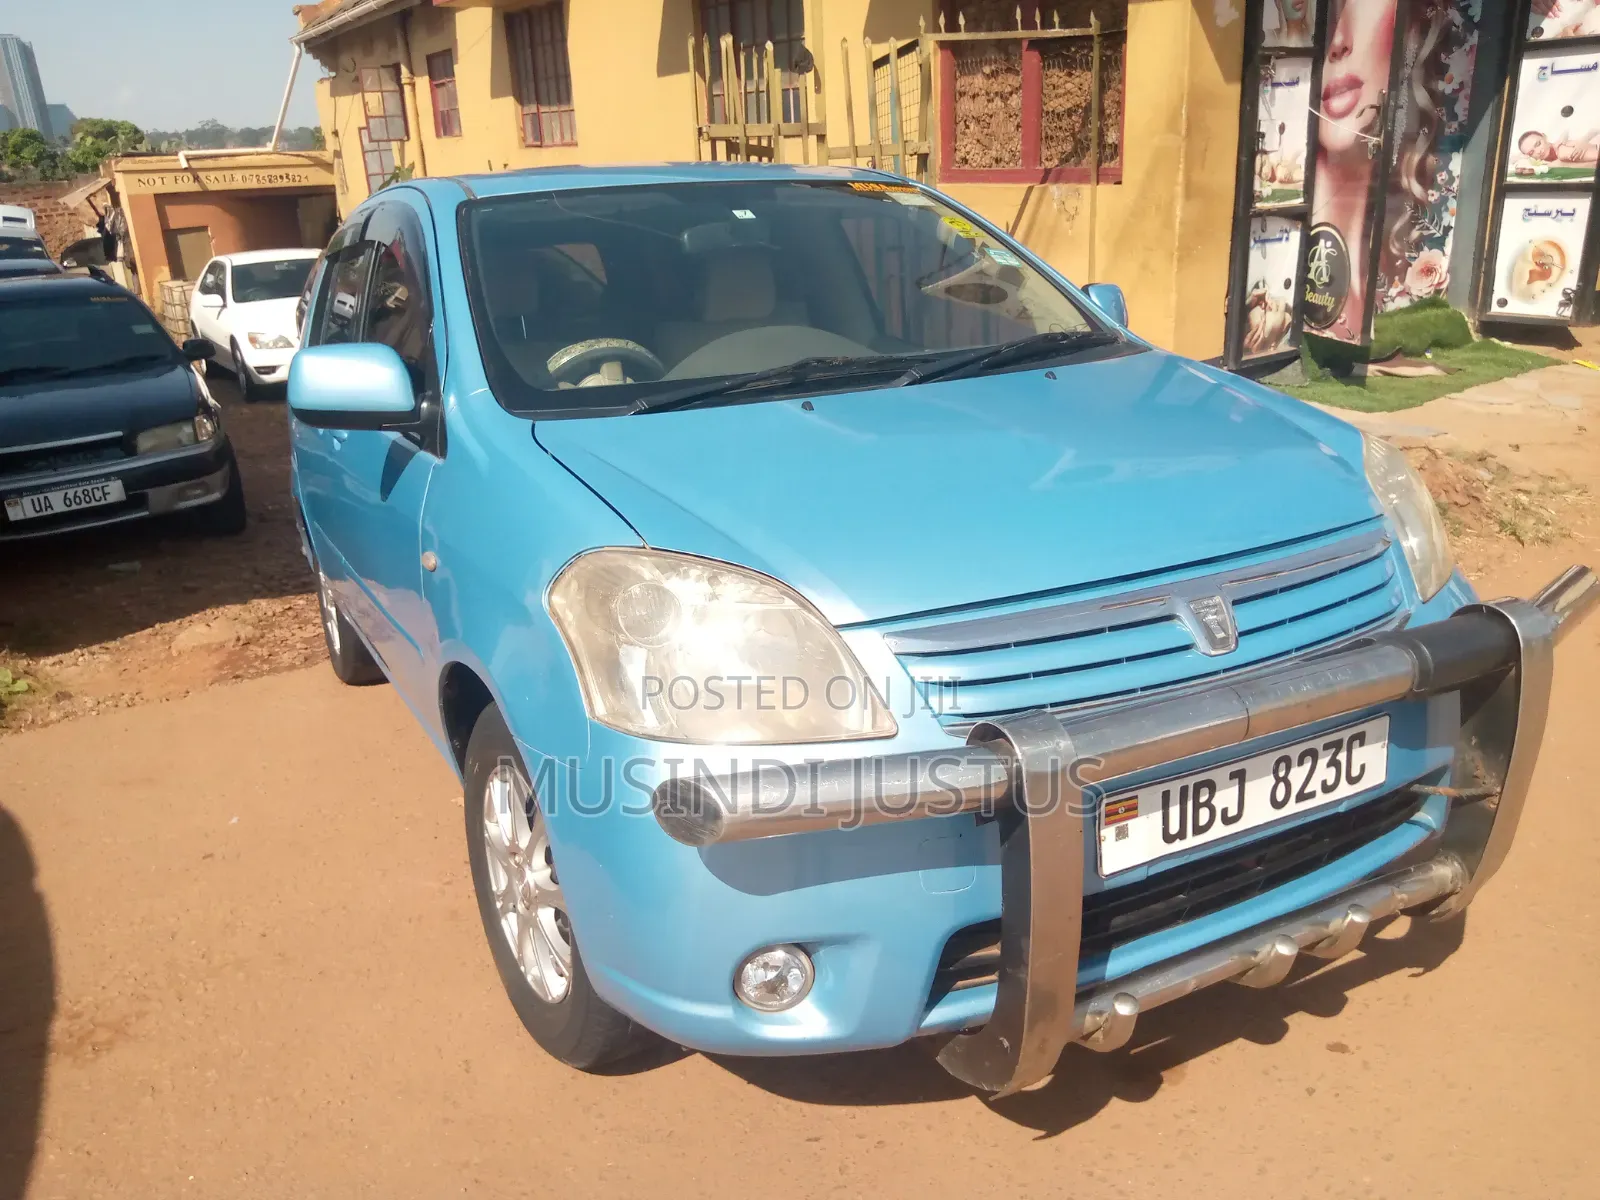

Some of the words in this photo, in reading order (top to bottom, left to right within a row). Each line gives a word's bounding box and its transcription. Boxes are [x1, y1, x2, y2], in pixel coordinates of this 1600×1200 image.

[137, 176, 167, 187] NOT
[174, 174, 200, 185] FOR
[31, 495, 54, 514] UA
[63, 484, 110, 508] 668CF
[1161, 767, 1247, 844] UBJ
[1269, 730, 1367, 810] 823C
